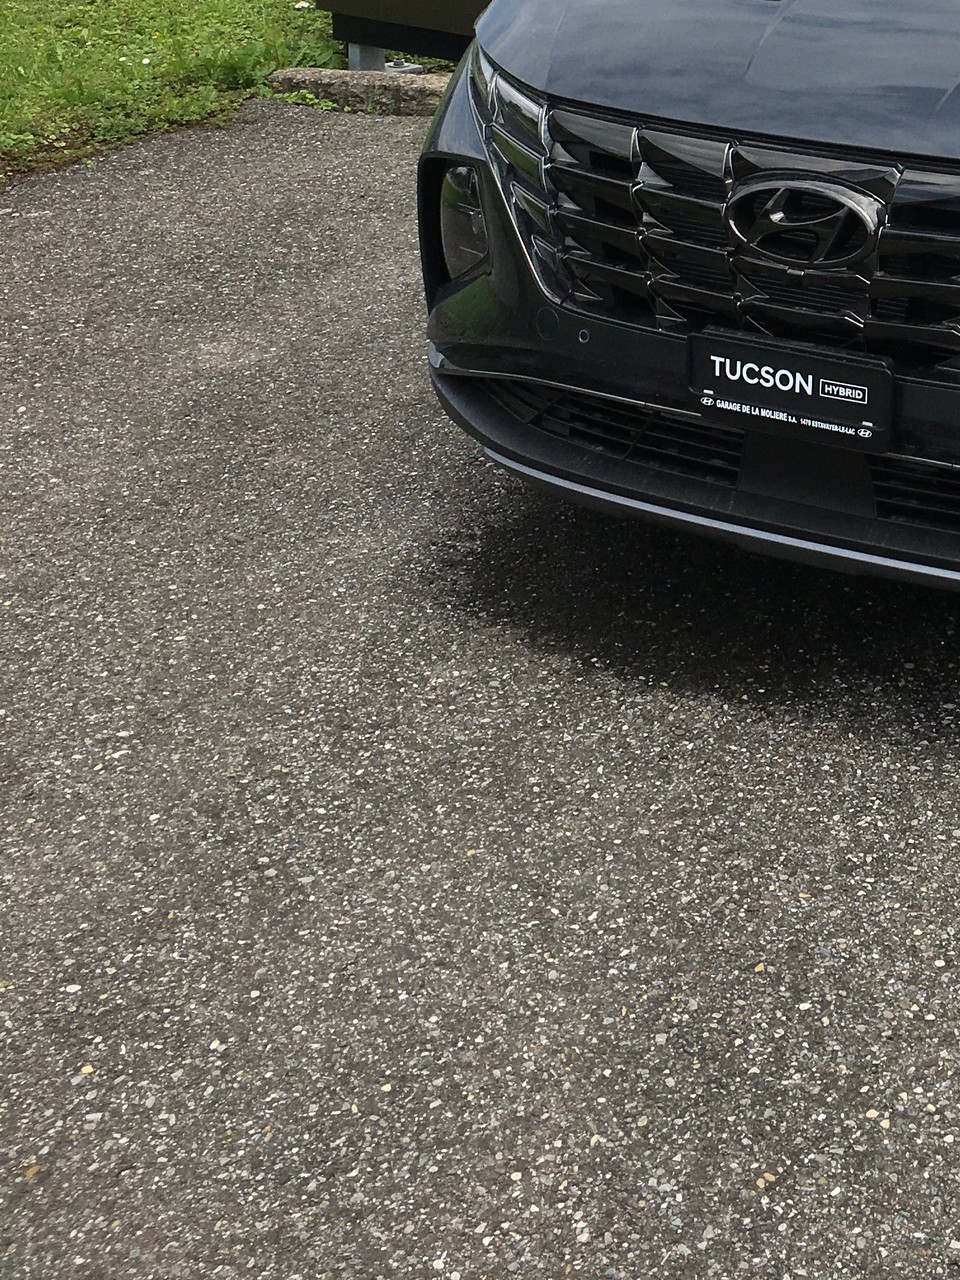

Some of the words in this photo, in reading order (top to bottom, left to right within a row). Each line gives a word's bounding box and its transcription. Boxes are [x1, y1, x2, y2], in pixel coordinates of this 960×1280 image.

[710, 355, 813, 396] TUCSON
[824, 384, 864, 400] HYBRID
[716, 400, 742, 412] GARAGE
[741, 404, 751, 414] DE
[751, 406, 760, 416] LA
[760, 408, 788, 422] MOLIERE
